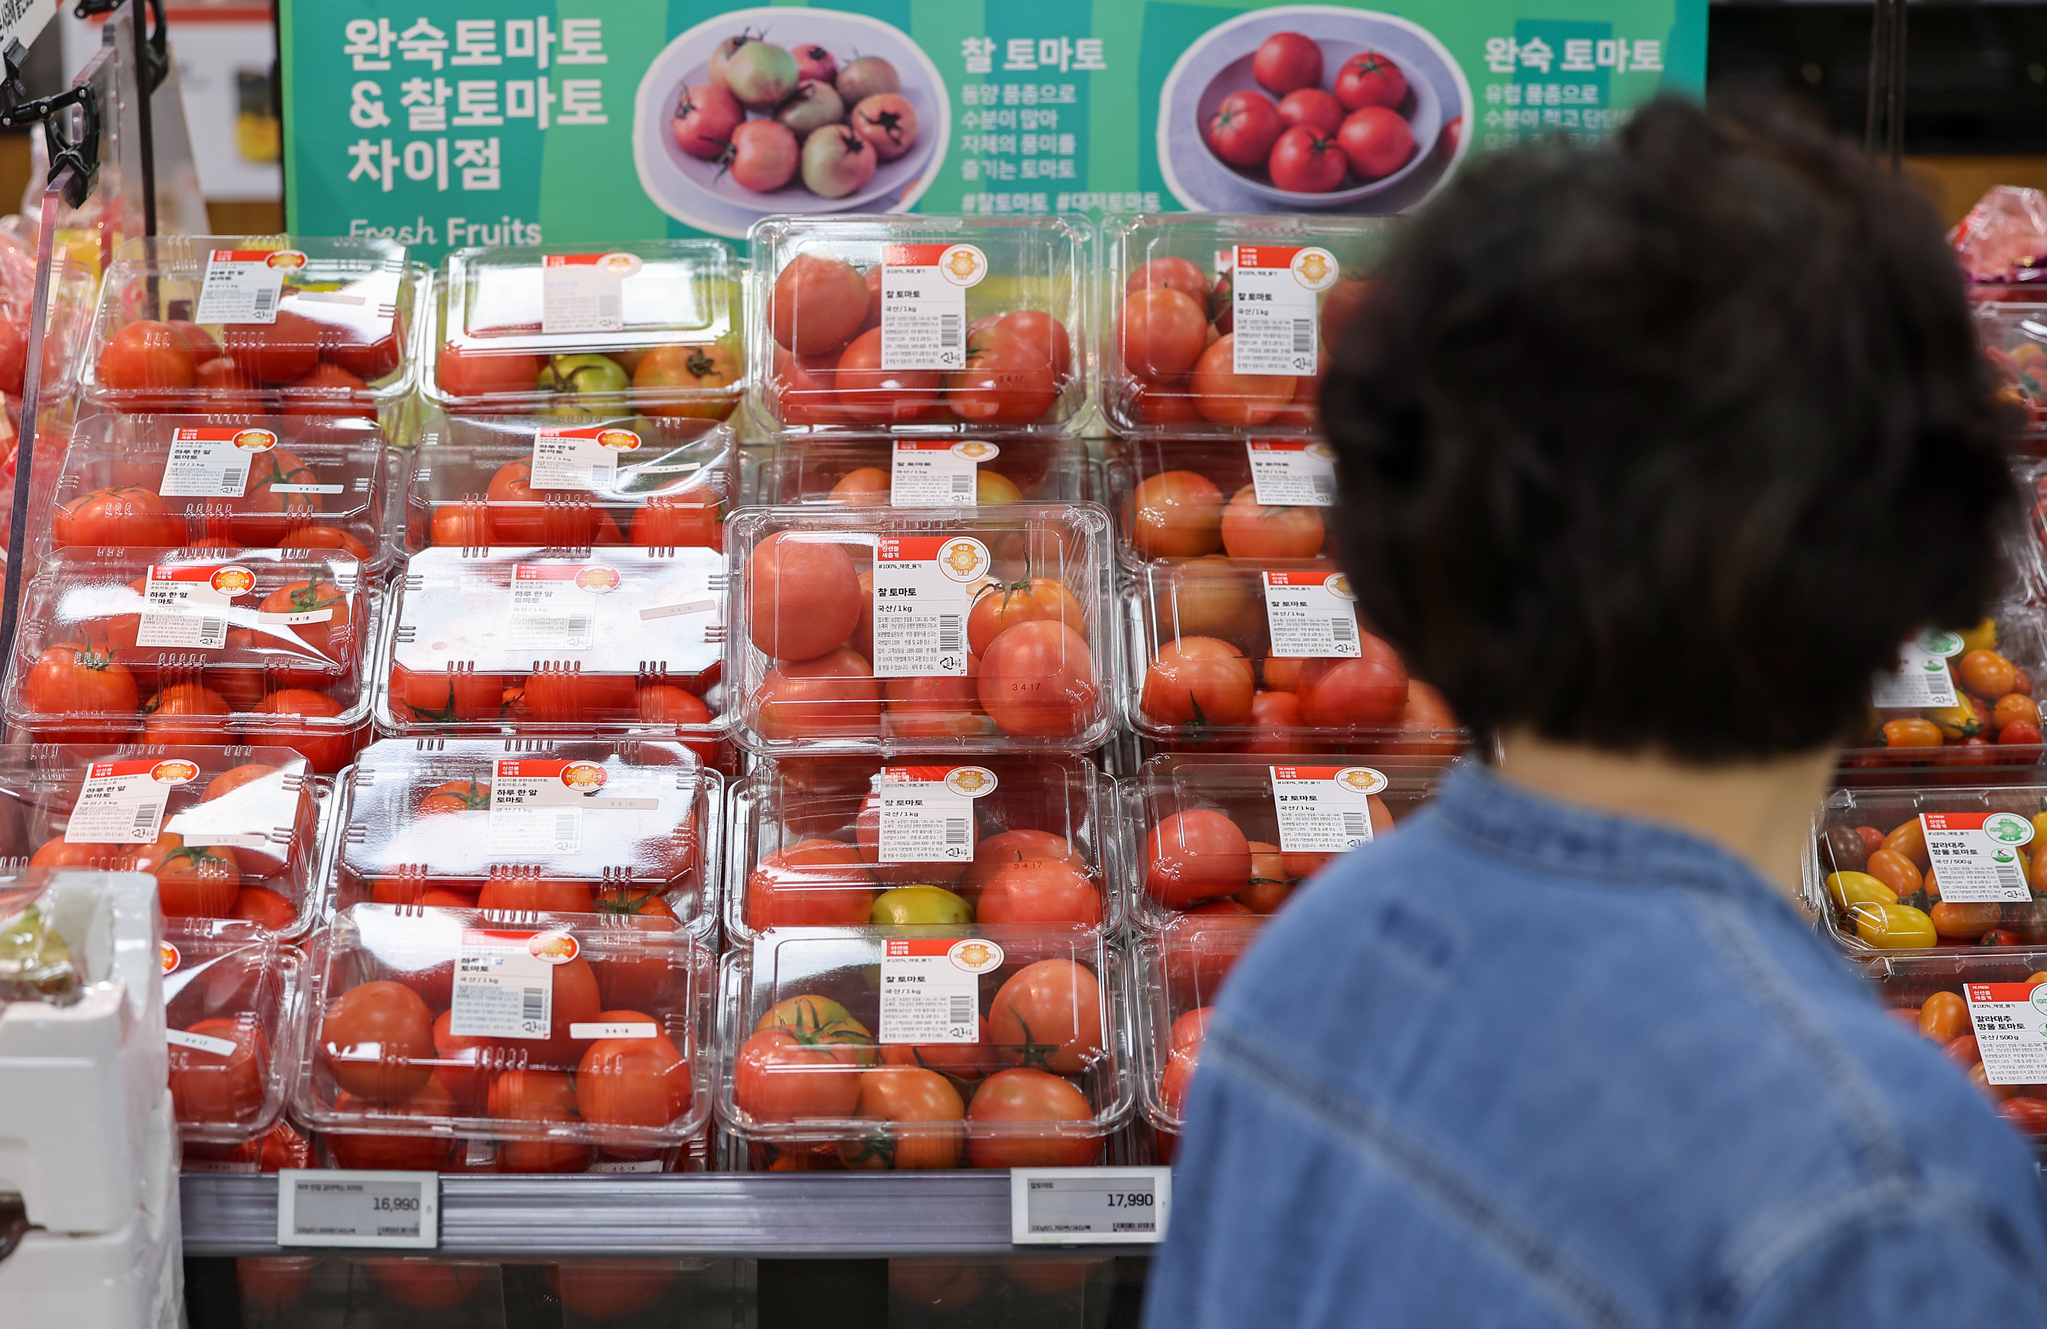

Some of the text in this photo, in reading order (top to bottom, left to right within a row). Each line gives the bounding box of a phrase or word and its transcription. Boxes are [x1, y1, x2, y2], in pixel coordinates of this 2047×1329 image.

[344, 15, 609, 71] 완숙토마토
[960, 36, 1107, 74] 찰 토마토
[1484, 36, 1664, 74] 완숙 토마토
[348, 76, 609, 132] & 찰토마토
[1002, 84, 1077, 106] 품종으로
[1484, 83, 1599, 106] 유럽 품종으로
[960, 108, 1059, 131] 수분이 많아
[1484, 108, 1539, 129] 수분이
[960, 133, 1077, 156] 자체의 풍미를
[347, 137, 501, 193] 차이점
[960, 158, 1077, 181] 즐기는 토마토
[446, 215, 544, 247] Fruits
[896, 290, 921, 299] 토마토
[1248, 293, 1273, 301] 토마토
[877, 587, 917, 597] 찰 토마토
[1012, 683, 1018, 691] 3
[1021, 683, 1026, 691] 4
[496, 789, 538, 797] 하루 한 알
[895, 799, 924, 807] 토마토
[373, 1197, 419, 1213] 16,990
[1107, 1193, 1154, 1209] 17,990
